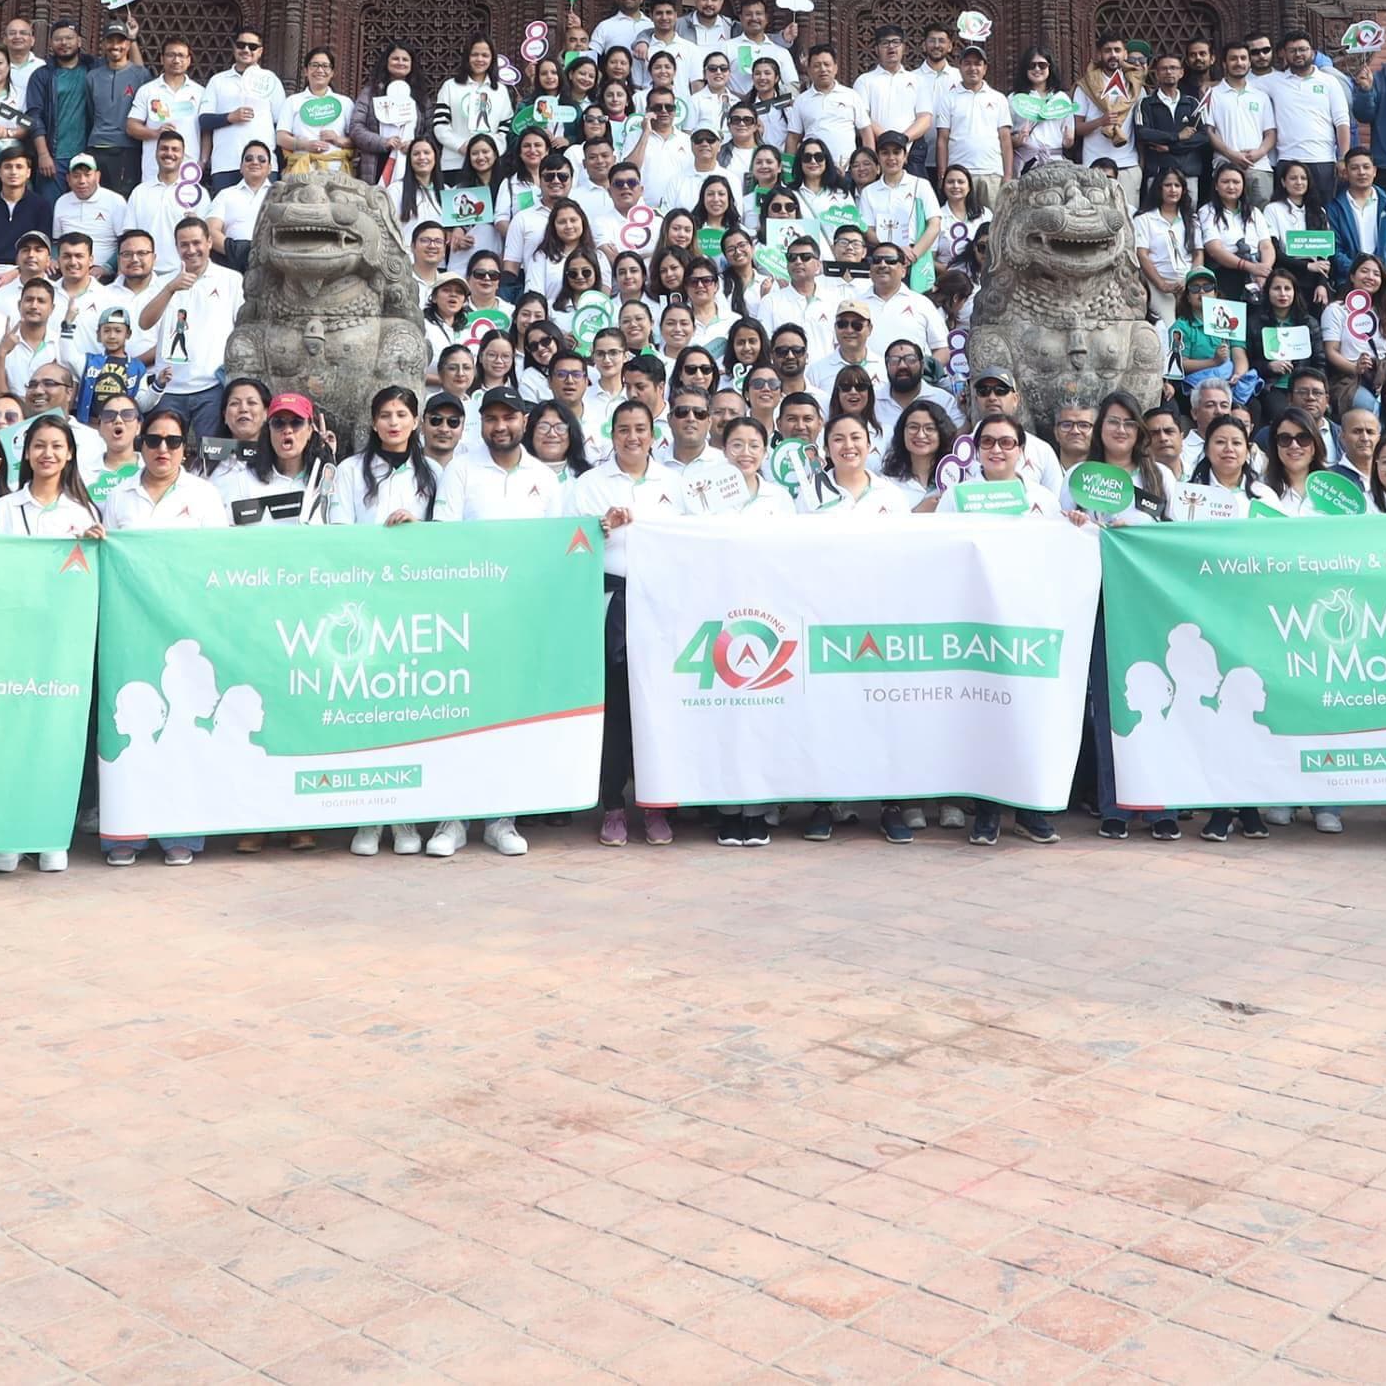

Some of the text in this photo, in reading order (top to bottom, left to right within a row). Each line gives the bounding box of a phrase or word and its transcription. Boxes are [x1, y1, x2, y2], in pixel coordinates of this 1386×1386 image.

[176, 163, 202, 208] 8
[621, 206, 654, 249] 8
[1346, 290, 1377, 341] 8
[204, 446, 221, 454] LADY
[1082, 473, 1124, 490] WOMEN
[1090, 486, 1122, 500] Motion
[206, 561, 509, 588] A Walk For Equality & Sustainability
[1199, 560, 1212, 575] A
[1217, 556, 1261, 575] Walk
[1267, 556, 1292, 573] For
[1298, 555, 1362, 575] Equality
[1368, 554, 1382, 569] &
[276, 605, 470, 660] WOMEN
[728, 608, 786, 634] CELEBRATING
[673, 620, 798, 691] 40
[821, 630, 1045, 667] NABIL BANK
[1286, 652, 1318, 678] IN
[290, 658, 470, 701] IN Motion
[682, 696, 785, 706] YEARS OF EXCELLENCE
[863, 687, 1012, 706] TOGETHER AHEAD
[322, 704, 470, 725] #AccelerateAction
[1305, 752, 1359, 768] NABIL
[300, 770, 412, 789] NABIL BANK
[1326, 777, 1370, 786] TOGETHER
